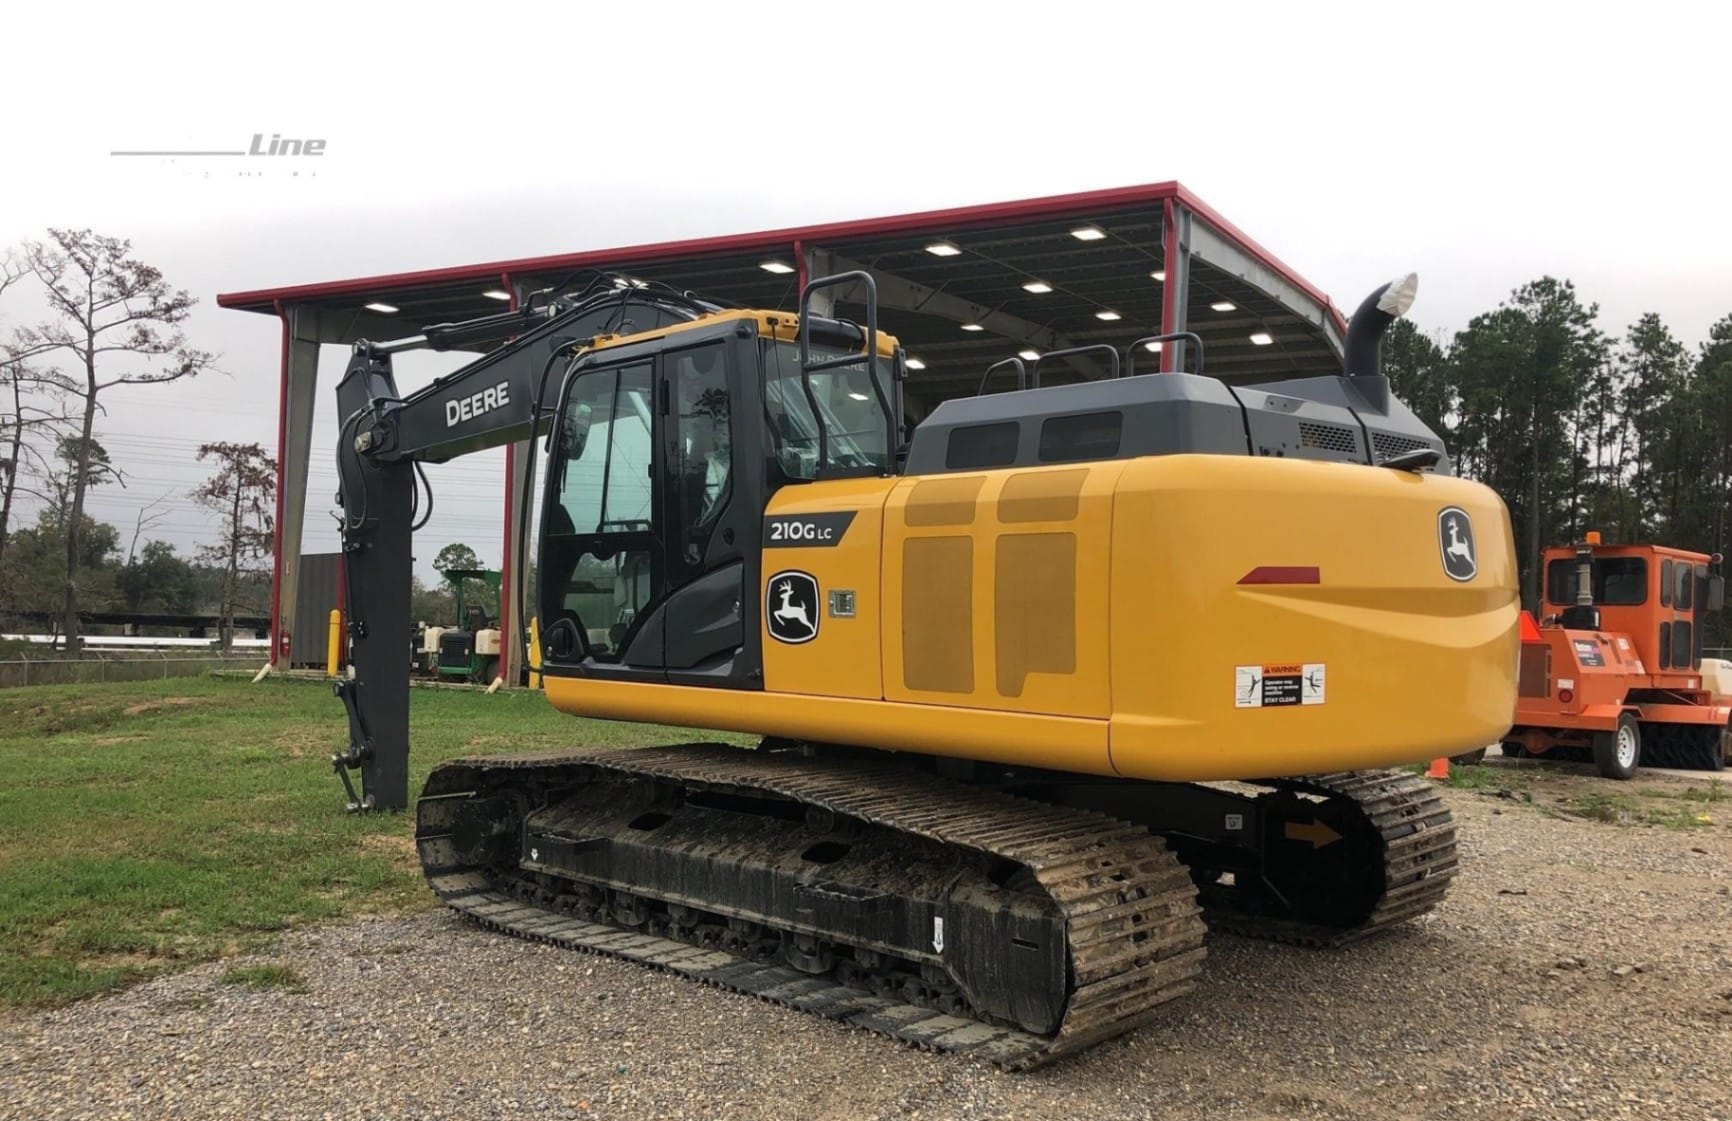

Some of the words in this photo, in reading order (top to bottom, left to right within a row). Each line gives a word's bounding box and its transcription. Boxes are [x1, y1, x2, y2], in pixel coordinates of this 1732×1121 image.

[793, 349, 825, 364] JHN
[446, 381, 510, 427] DEERE
[771, 521, 815, 540] 210G
[817, 528, 832, 539] LC
[1270, 665, 1301, 673] WARNING
